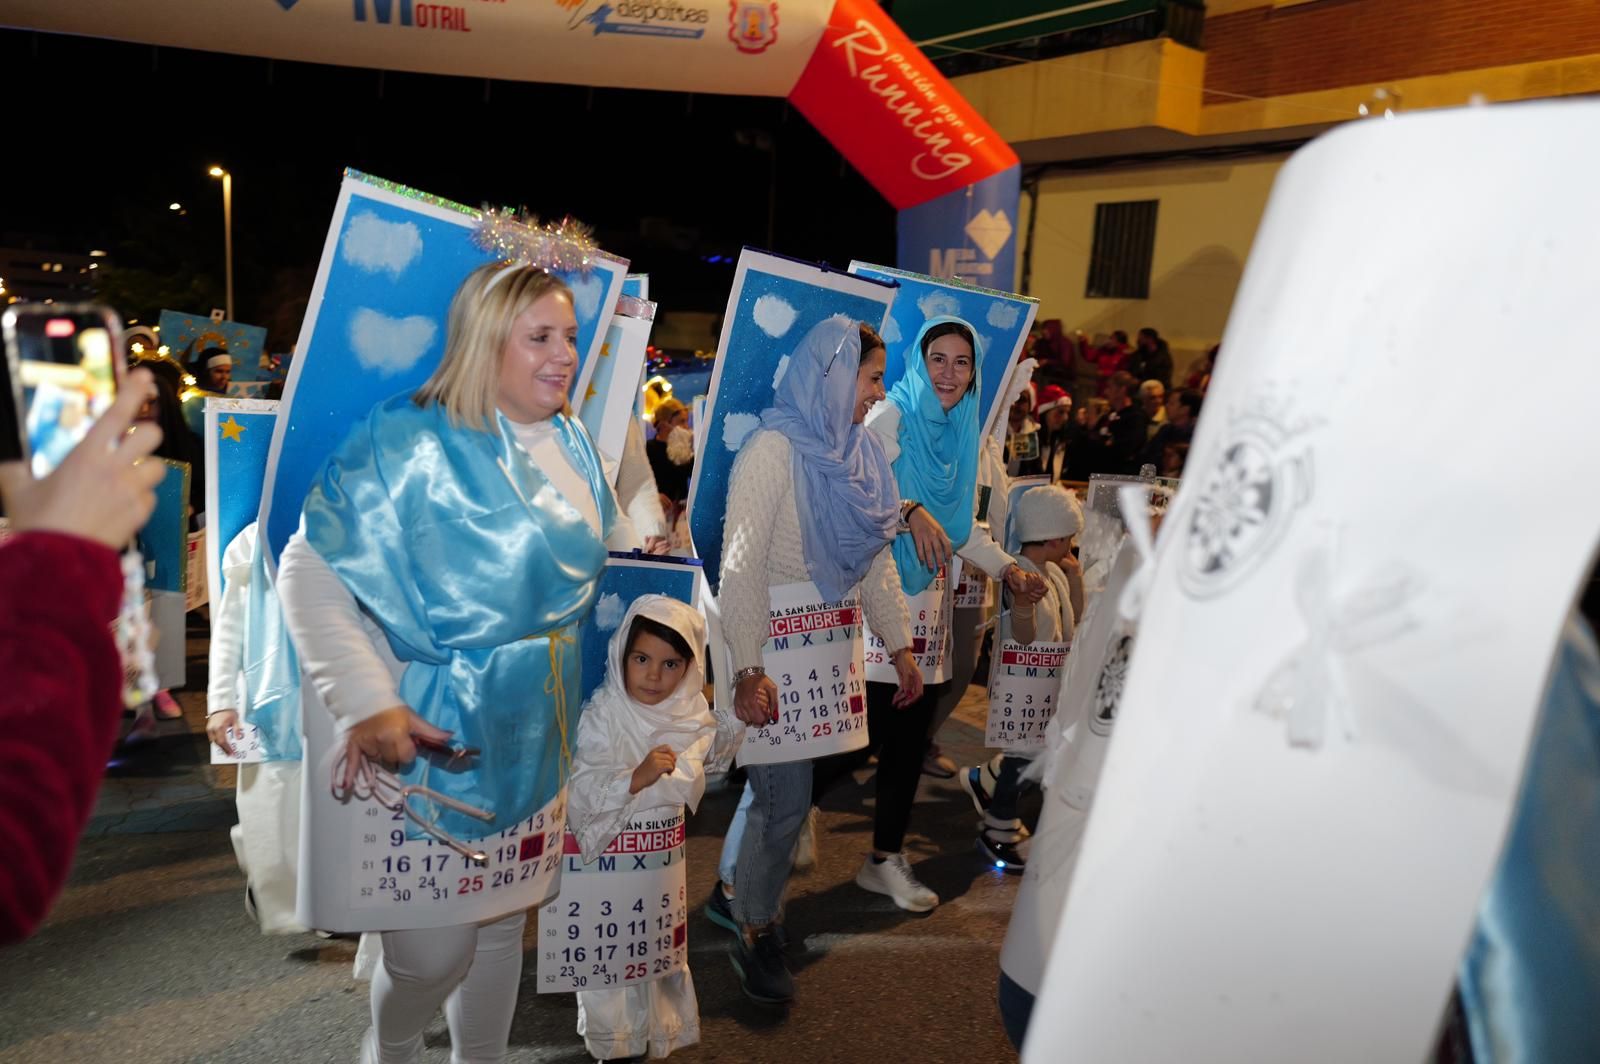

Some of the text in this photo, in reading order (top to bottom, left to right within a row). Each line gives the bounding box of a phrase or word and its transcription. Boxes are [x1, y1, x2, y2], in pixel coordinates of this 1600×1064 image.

[617, 0, 709, 24] deportes
[832, 19, 972, 180] Running
[932, 104, 964, 129] por
[962, 132, 985, 146] el
[785, 605, 804, 616] SAN
[918, 610, 926, 621] 6
[769, 611, 842, 636] ICIEMBRE
[914, 625, 927, 636] 13
[930, 627, 938, 636] 14
[774, 637, 789, 650] M
[801, 632, 814, 646] X
[826, 629, 834, 642] J
[843, 626, 851, 640] V
[868, 636, 885, 648] 18
[927, 640, 937, 652] 21
[1003, 644, 1038, 653] CARRERA
[866, 652, 883, 664] 25
[926, 656, 936, 667] 28
[782, 662, 856, 687] 3 4 5 6
[1007, 666, 1056, 677] L M X
[780, 680, 861, 705] 10 11 12 13
[1005, 693, 1051, 704] 2 3 4
[782, 709, 802, 723] 17
[809, 704, 829, 719] 18
[834, 700, 849, 714] 19
[1004, 707, 1051, 718] 9 10 11
[758, 715, 864, 738] 23 24 25 26 27
[1000, 721, 1015, 731] 16
[1020, 722, 1034, 731] 17
[769, 735, 782, 745] 30
[794, 732, 807, 742] 31
[391, 803, 405, 820] 2
[390, 829, 404, 847] 9
[526, 813, 544, 832] 13
[625, 821, 642, 831] AN
[382, 855, 411, 873] 16
[421, 854, 450, 872] 17
[496, 844, 516, 863] 19
[569, 857, 581, 872] L
[599, 856, 616, 871] M
[633, 854, 647, 870] X
[663, 851, 672, 866] J
[379, 852, 560, 895] 23 24 25 26 27 28
[393, 889, 411, 901] 30
[432, 887, 448, 900] 31
[568, 902, 580, 917] 2
[601, 901, 612, 916] 3
[632, 898, 644, 913] 4
[661, 893, 670, 909] 5
[568, 924, 580, 940] 9
[595, 922, 618, 939] 10
[627, 919, 646, 936] 11
[656, 913, 672, 930] 12
[562, 947, 586, 963] 16
[594, 944, 618, 961] 17
[626, 941, 647, 957] 18
[655, 934, 671, 952] 19
[560, 965, 575, 977] 23
[592, 963, 607, 975] 24
[624, 962, 647, 980] 25
[653, 955, 670, 974] 26
[572, 976, 587, 987] 30
[604, 973, 617, 985] 31
